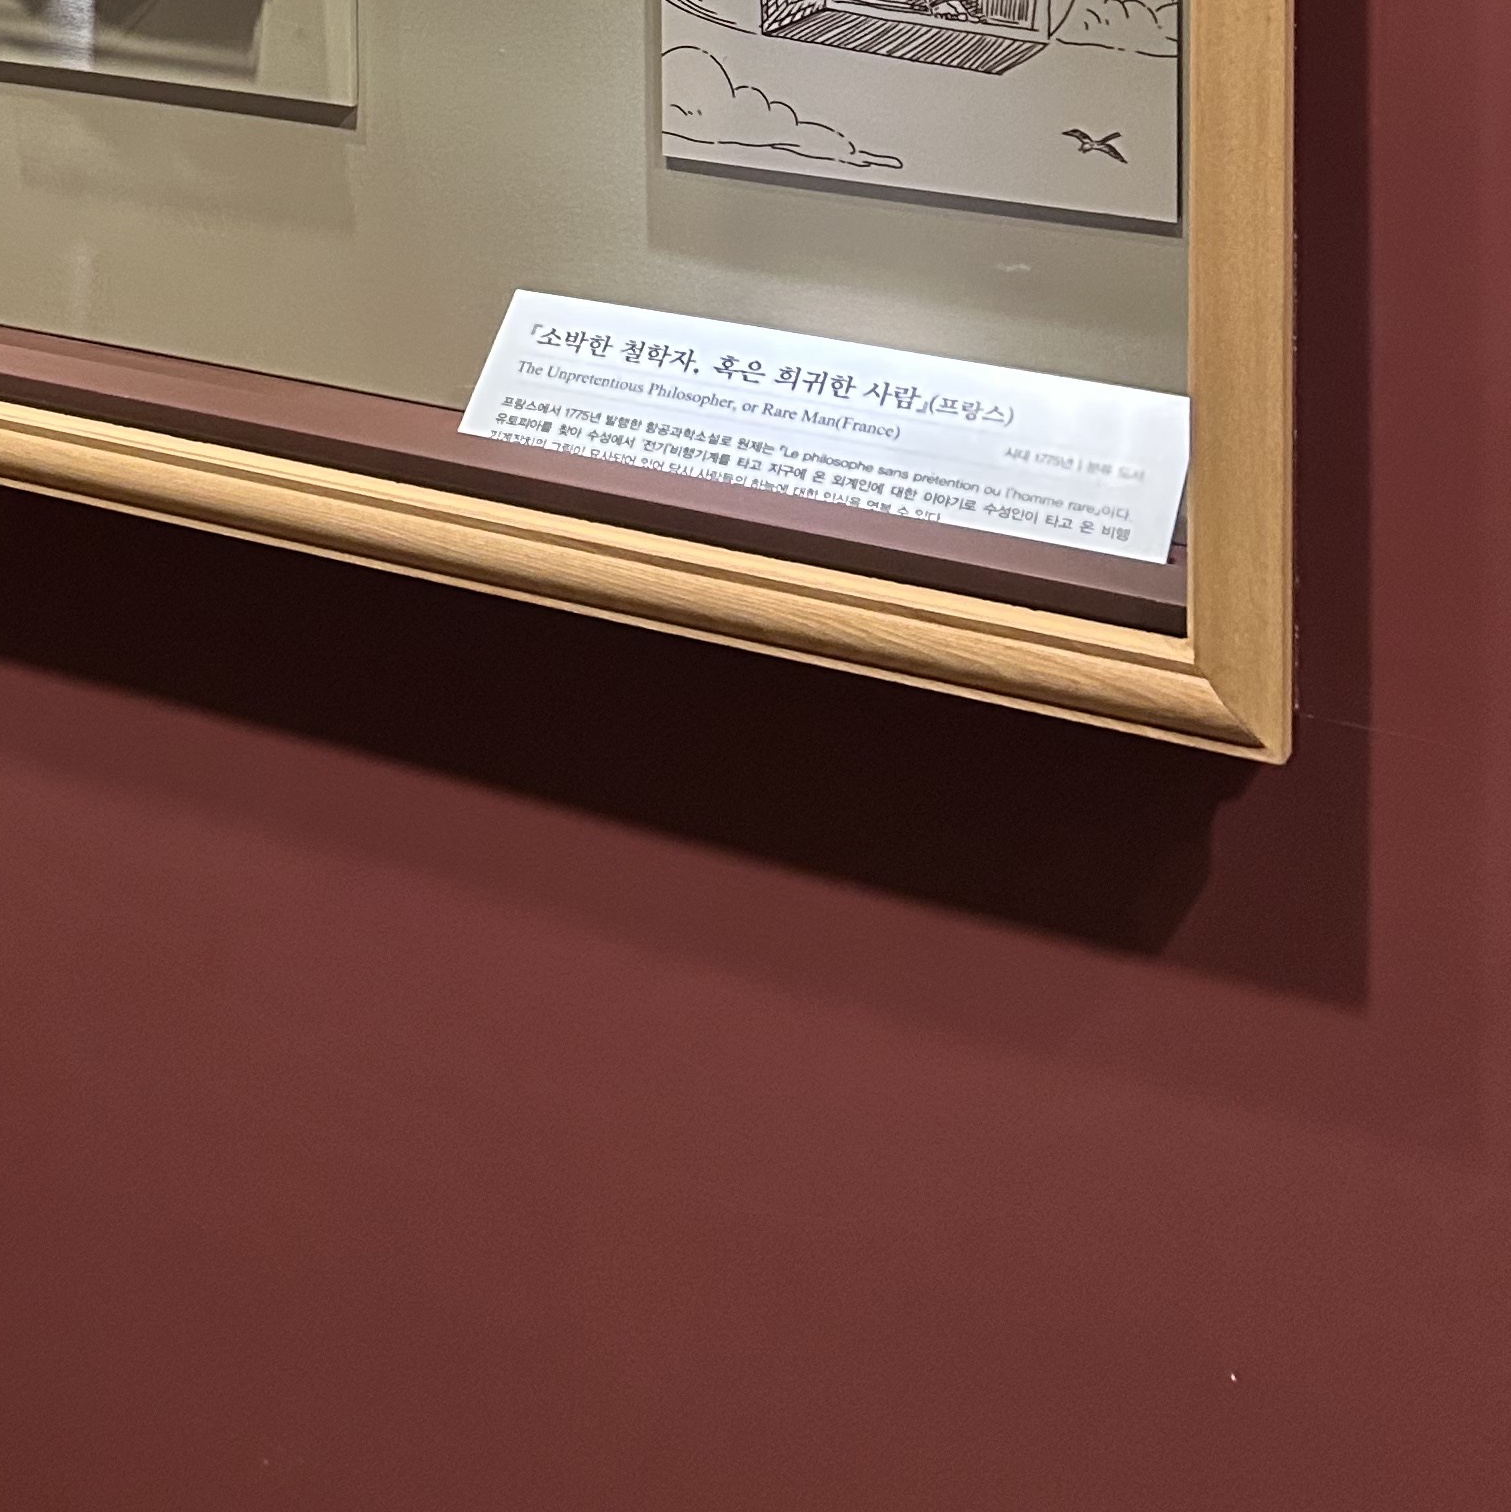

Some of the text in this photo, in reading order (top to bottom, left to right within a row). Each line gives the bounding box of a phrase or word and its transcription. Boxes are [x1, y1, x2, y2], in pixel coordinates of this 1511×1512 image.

[518, 360, 900, 440] The Unpretentious Philosopher, or Rare Man(France)
[713, 354, 766, 384] 혹은
[773, 366, 856, 400] 희귀한
[496, 412, 552, 434] 유토피아를
[559, 424, 582, 438] 찾아
[587, 430, 636, 449] 수성에서
[736, 457, 762, 471] 타고
[768, 462, 808, 481] 지구에
[812, 470, 826, 484] 온
[831, 474, 885, 495] 외계인에
[890, 486, 918, 501] 대한
[924, 492, 978, 512] 이야기로
[983, 502, 1038, 524] 수성인이
[1045, 514, 1073, 530] 타고
[1079, 520, 1095, 535] 온
[1101, 525, 1131, 542] 비행
[501, 396, 562, 416] 프랑스에서
[566, 408, 602, 424] 1775년
[606, 414, 642, 431] 발행한
[646, 420, 732, 446] 항공과학소설로
[738, 437, 775, 455] 원제는
[802, 452, 874, 474] philosophe
[878, 465, 908, 480] sans
[984, 487, 1000, 496] ou
